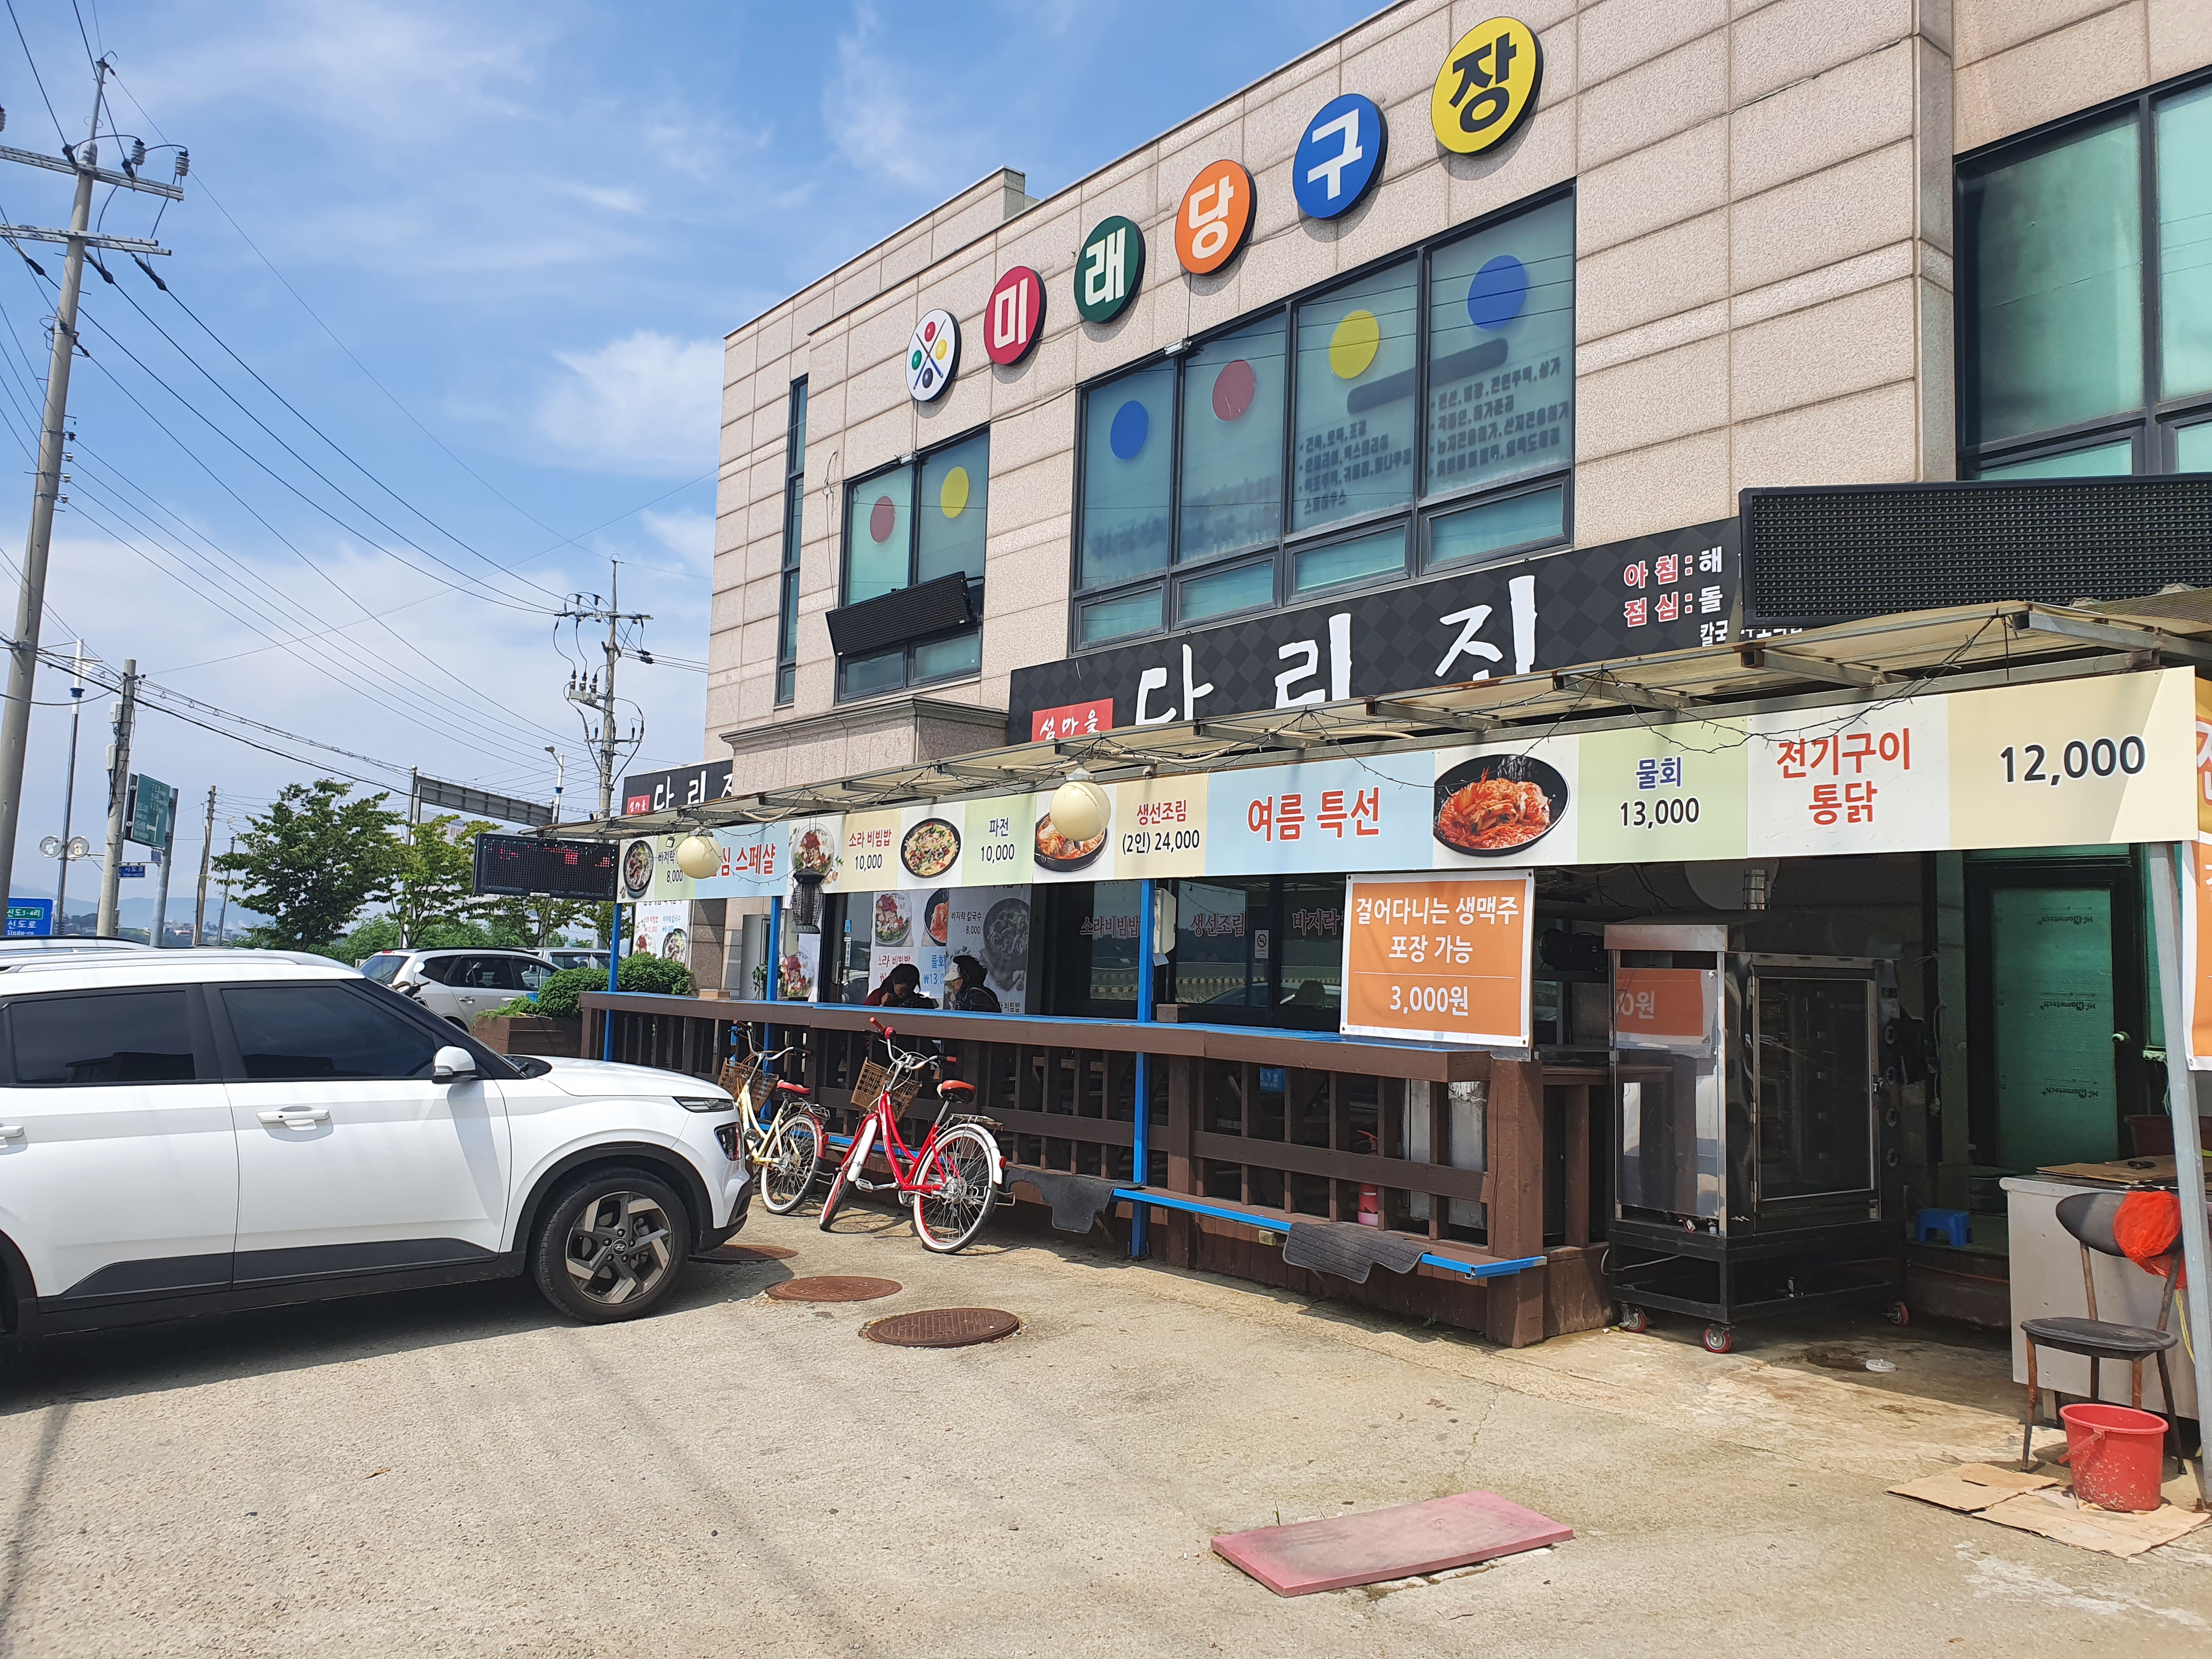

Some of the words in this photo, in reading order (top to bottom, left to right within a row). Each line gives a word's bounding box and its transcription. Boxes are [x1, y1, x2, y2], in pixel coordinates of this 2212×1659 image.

[1040, 709, 1101, 741] 섬마을
[1777, 727, 1911, 780] 전기구이
[2000, 736, 2146, 787] 12,000
[1636, 755, 1683, 789] 물회
[1136, 799, 1188, 826] 생선조림
[1247, 793, 1304, 843] 여름
[1317, 786, 1381, 839] 특선
[1620, 797, 1700, 830] 13,000
[1809, 781, 1878, 826] 통닭
[849, 831, 865, 849] 소라
[867, 828, 892, 848] 비빔밥
[989, 817, 1009, 839] 파전
[980, 844, 1015, 865] 10,000
[1122, 832, 1150, 855] (2인)
[1154, 829, 1200, 853] 24,000
[658, 850, 675, 866] 바지락
[735, 843, 776, 876] 스페샬
[855, 854, 883, 871] 10,000
[667, 869, 684, 884] 8,000
[951, 911, 966, 922] 바지락
[967, 911, 983, 922] 칼국수
[1356, 895, 1450, 927] 걸어다니는
[1456, 897, 1520, 926] 생맥주
[7, 919, 37, 930] 신도로
[965, 925, 981, 935] 8,000
[1080, 915, 1139, 939] 소라비빔밥
[1190, 912, 1245, 937] 생선조림
[877, 953, 890, 968] 소라
[1389, 935, 1429, 964] 포장
[1434, 934, 1474, 964] 가능
[1390, 986, 1469, 1017] 3,000원
